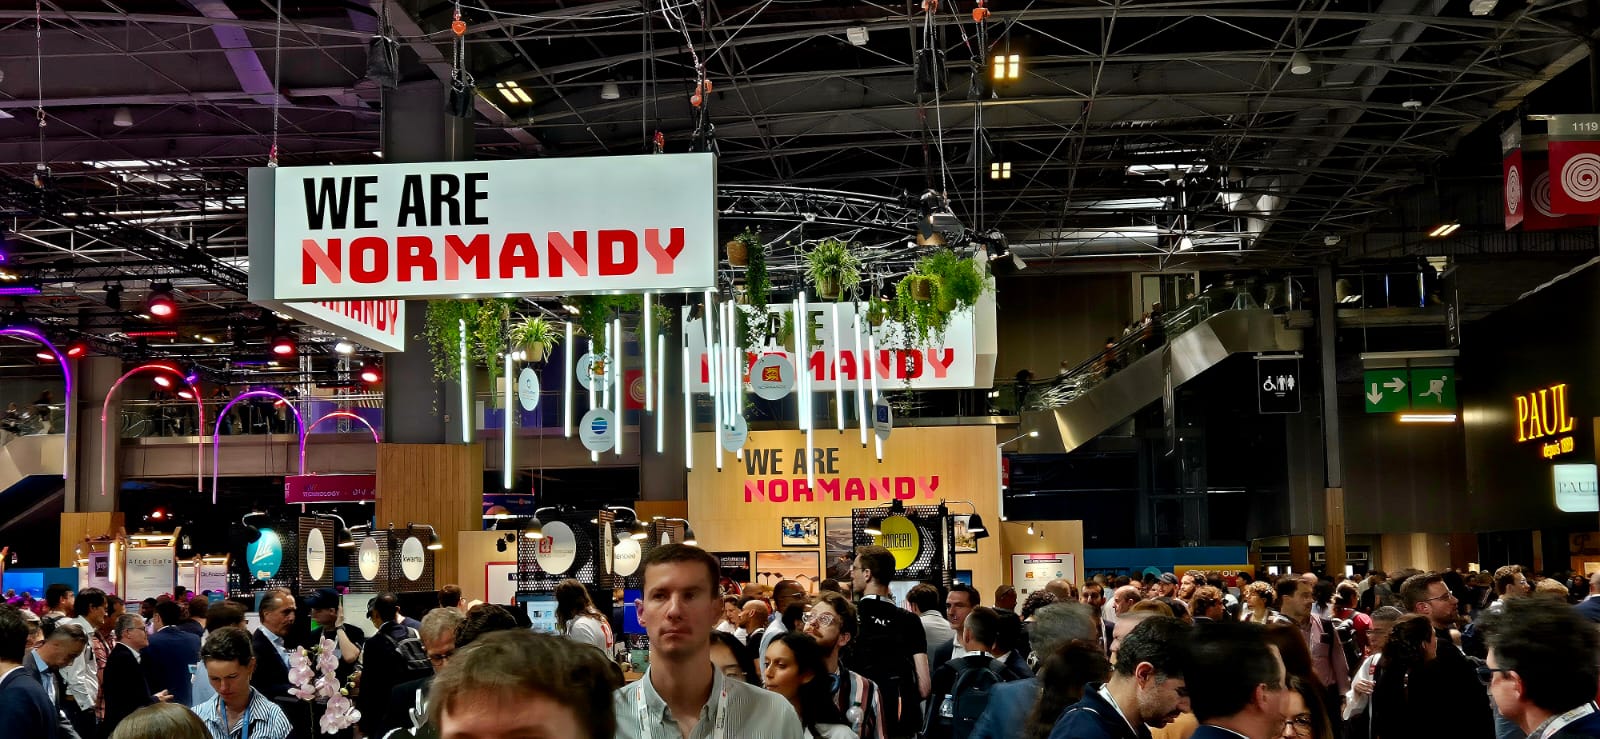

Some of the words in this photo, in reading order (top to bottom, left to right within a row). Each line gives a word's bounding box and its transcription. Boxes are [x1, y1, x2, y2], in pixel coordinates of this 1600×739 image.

[1572, 122, 1598, 131] 1119
[302, 175, 379, 231] WE
[397, 172, 489, 228] ARE
[302, 227, 685, 285] NORMANDY
[763, 310, 825, 347] AE
[700, 347, 954, 384] MANDY
[1516, 384, 1574, 442] PAUL
[744, 449, 783, 476] WE
[792, 447, 840, 475] ARE
[744, 475, 940, 503] NORMANDY
